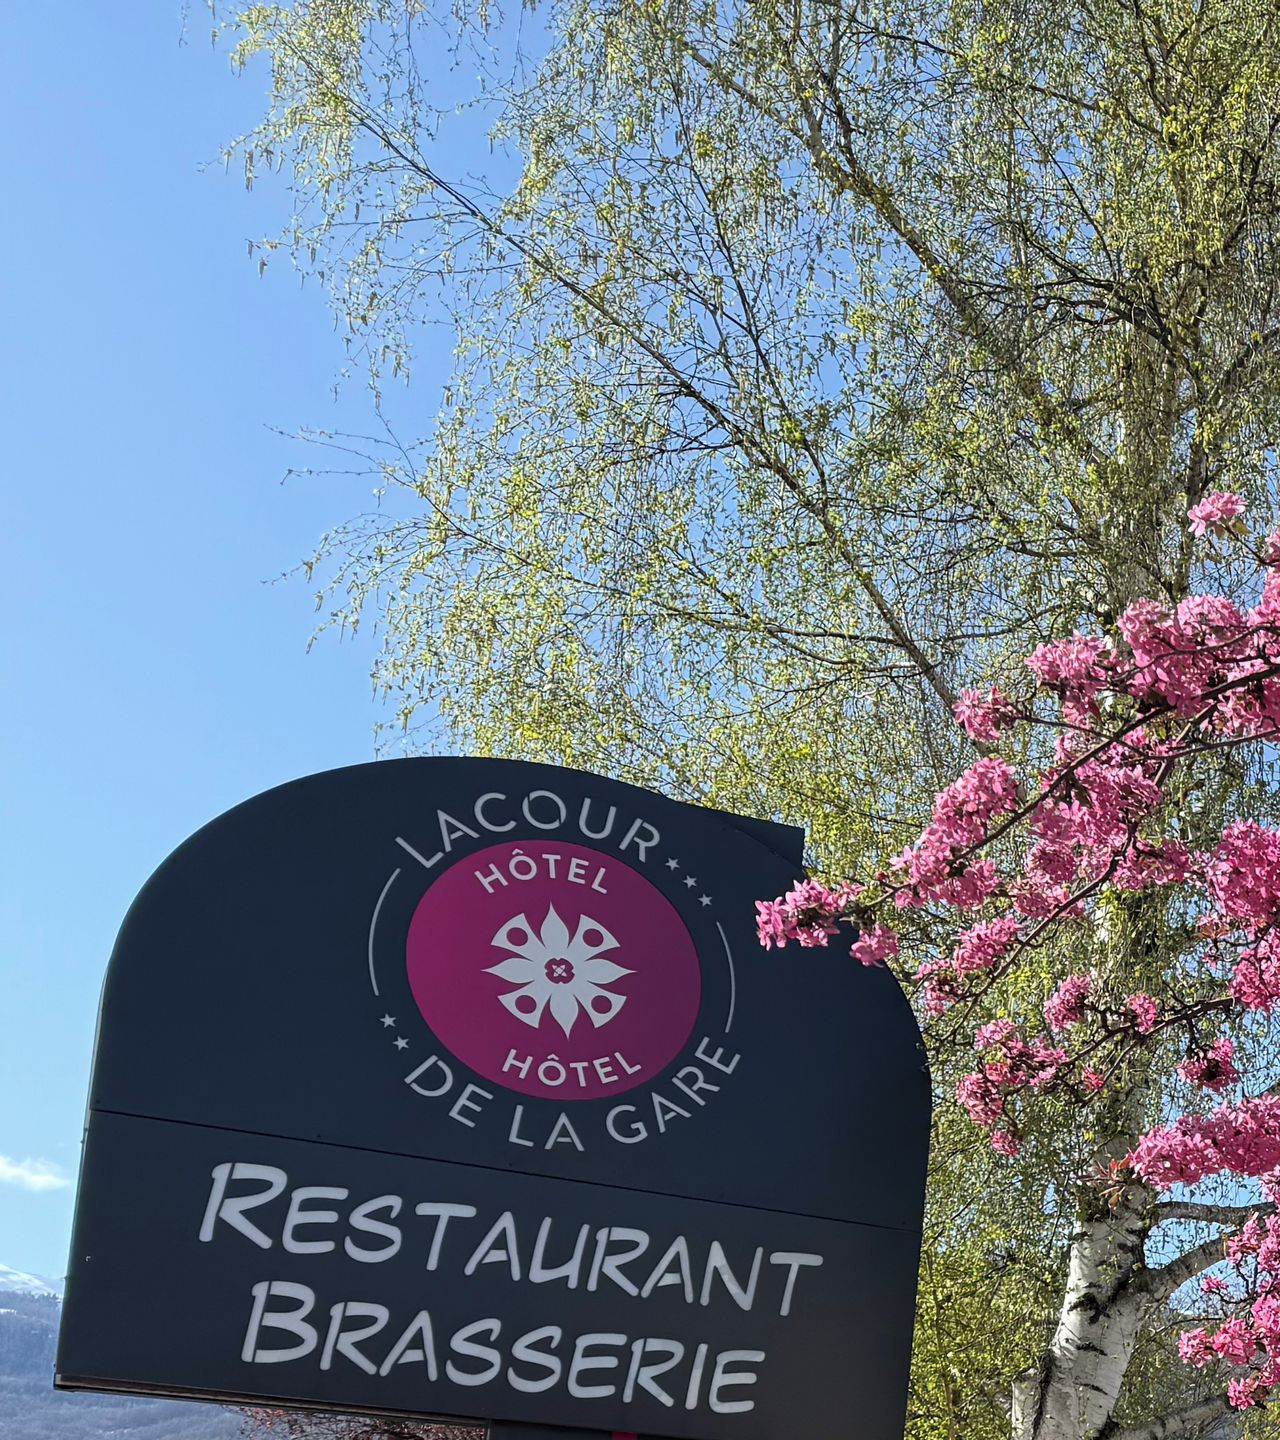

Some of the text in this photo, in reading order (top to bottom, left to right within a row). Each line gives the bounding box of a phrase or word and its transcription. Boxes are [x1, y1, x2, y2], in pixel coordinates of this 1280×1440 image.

[395, 790, 661, 868] LACOUR
[474, 848, 608, 894] HÔTEL
[403, 1036, 742, 1152] DE LA GARE
[501, 1048, 642, 1087] HÔTEL
[199, 1161, 823, 1317] RESTAURANT
[241, 1280, 766, 1414] BRASSERIE
